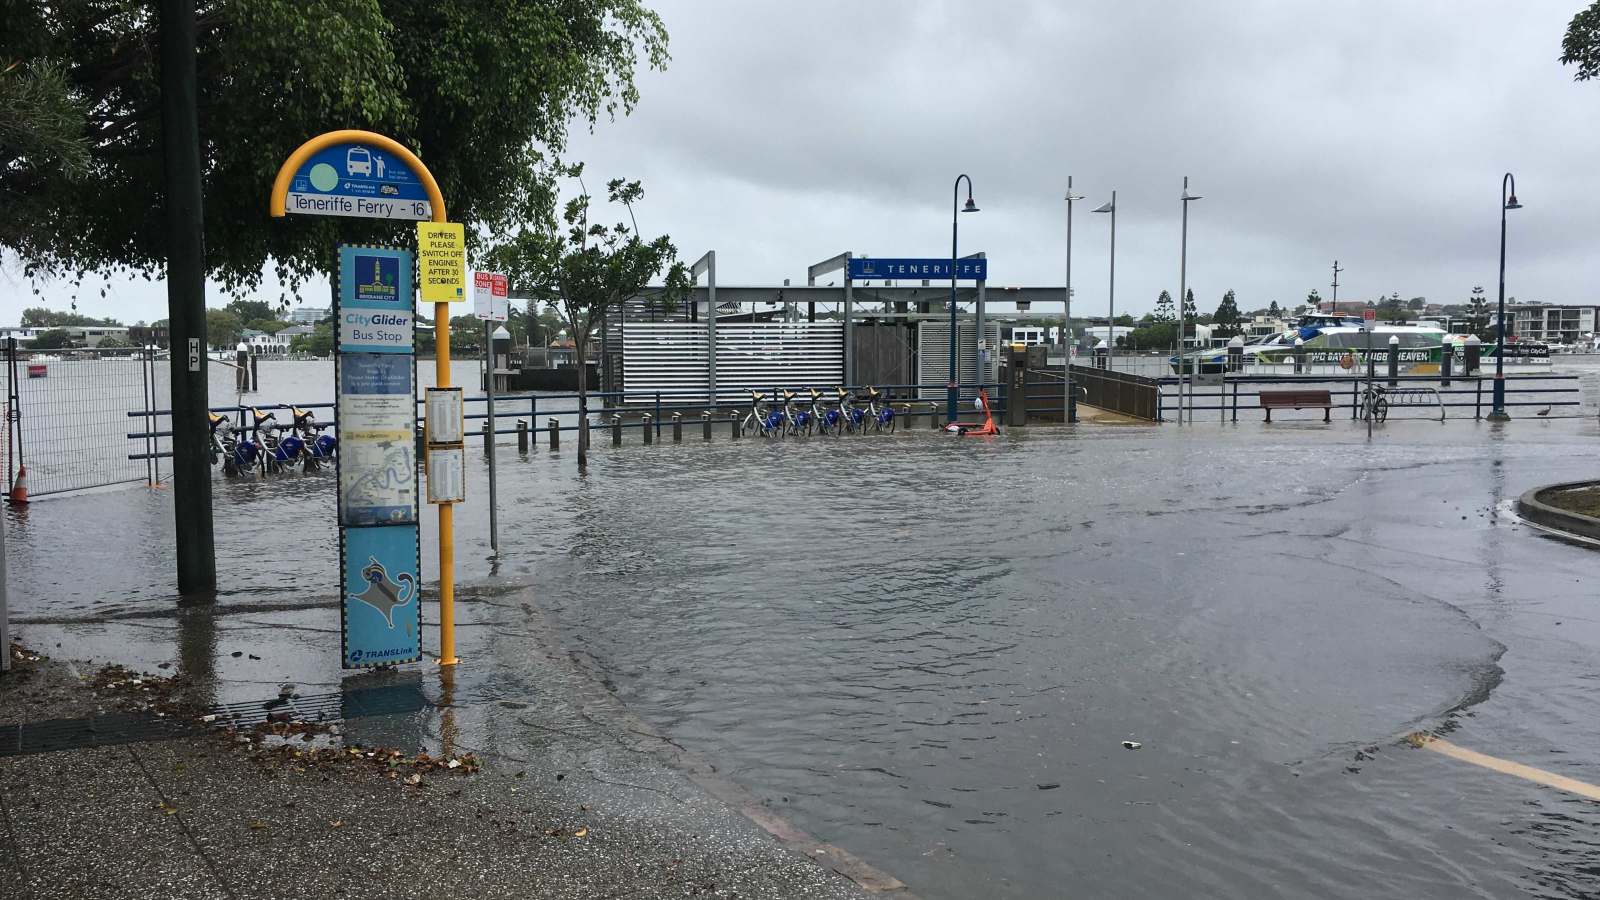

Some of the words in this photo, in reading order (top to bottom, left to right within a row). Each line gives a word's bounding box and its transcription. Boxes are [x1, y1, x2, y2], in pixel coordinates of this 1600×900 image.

[292, 194, 352, 212] Teneriffe
[357, 199, 394, 217] Ferry
[410, 203, 425, 215] 16
[428, 231, 457, 240] DRIVERS
[422, 249, 448, 257] SWITCH
[428, 259, 458, 267] ENGINES
[428, 268, 450, 276] AFTER
[476, 272, 489, 280] BUS
[428, 277, 460, 285] SECONDS
[475, 280, 491, 288] ZONE
[346, 313, 408, 327] CityGlider
[353, 329, 374, 340] Bus
[376, 330, 402, 343] Stop
[1311, 352, 1325, 361] WO
[1364, 352, 1389, 361] UGB
[365, 647, 413, 658] TRANSLink
